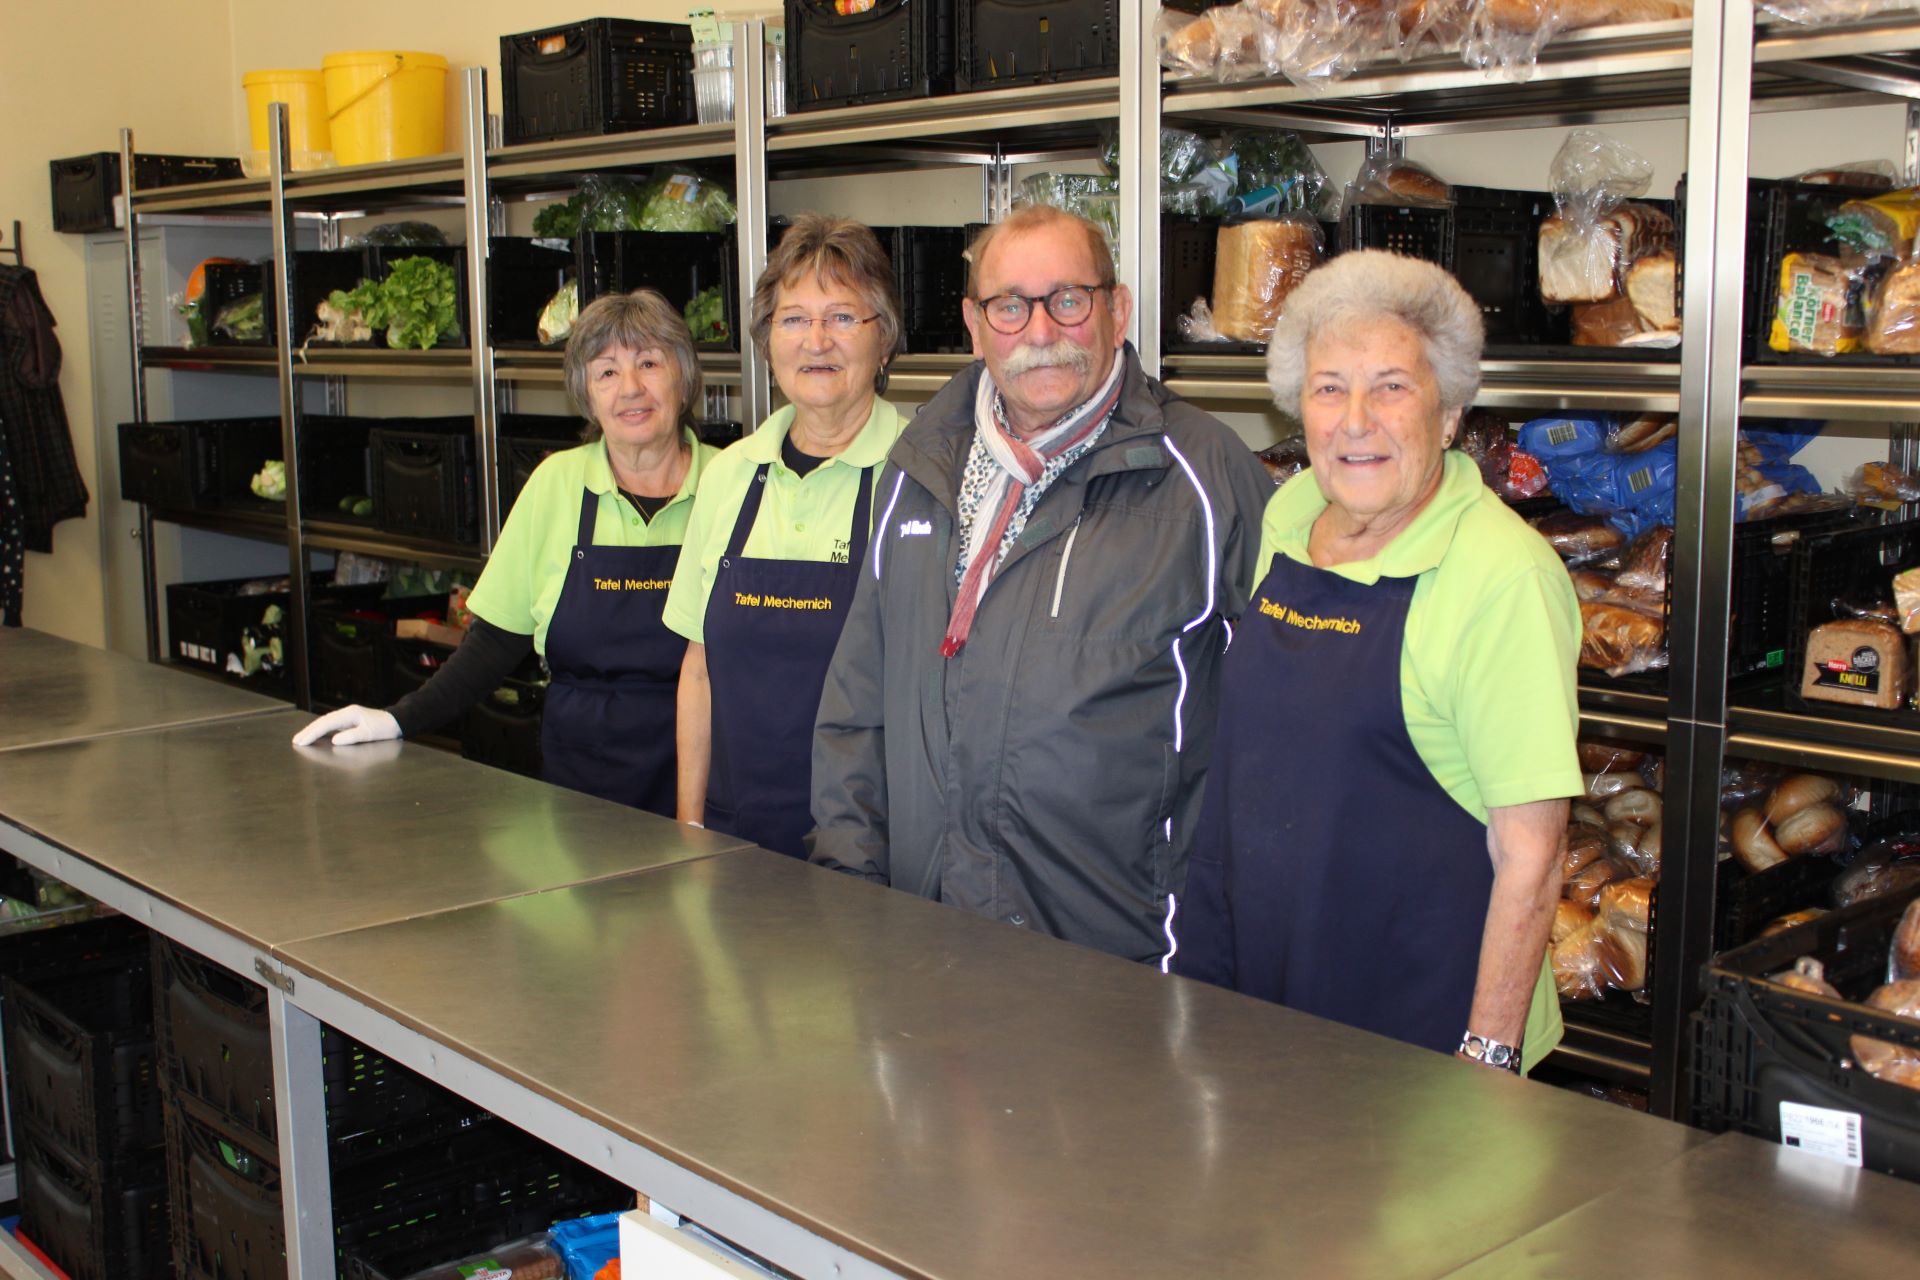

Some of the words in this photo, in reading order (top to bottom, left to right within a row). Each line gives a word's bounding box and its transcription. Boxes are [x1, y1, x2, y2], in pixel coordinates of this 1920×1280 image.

[1790, 274, 1809, 337] Balance
[1801, 288, 1821, 342] Körner
[594, 578, 621, 591] Tafel
[735, 592, 761, 607] Tafel
[763, 595, 832, 610] Mechernich
[1259, 598, 1287, 620] Tafel
[1286, 609, 1361, 635] Mechernich
